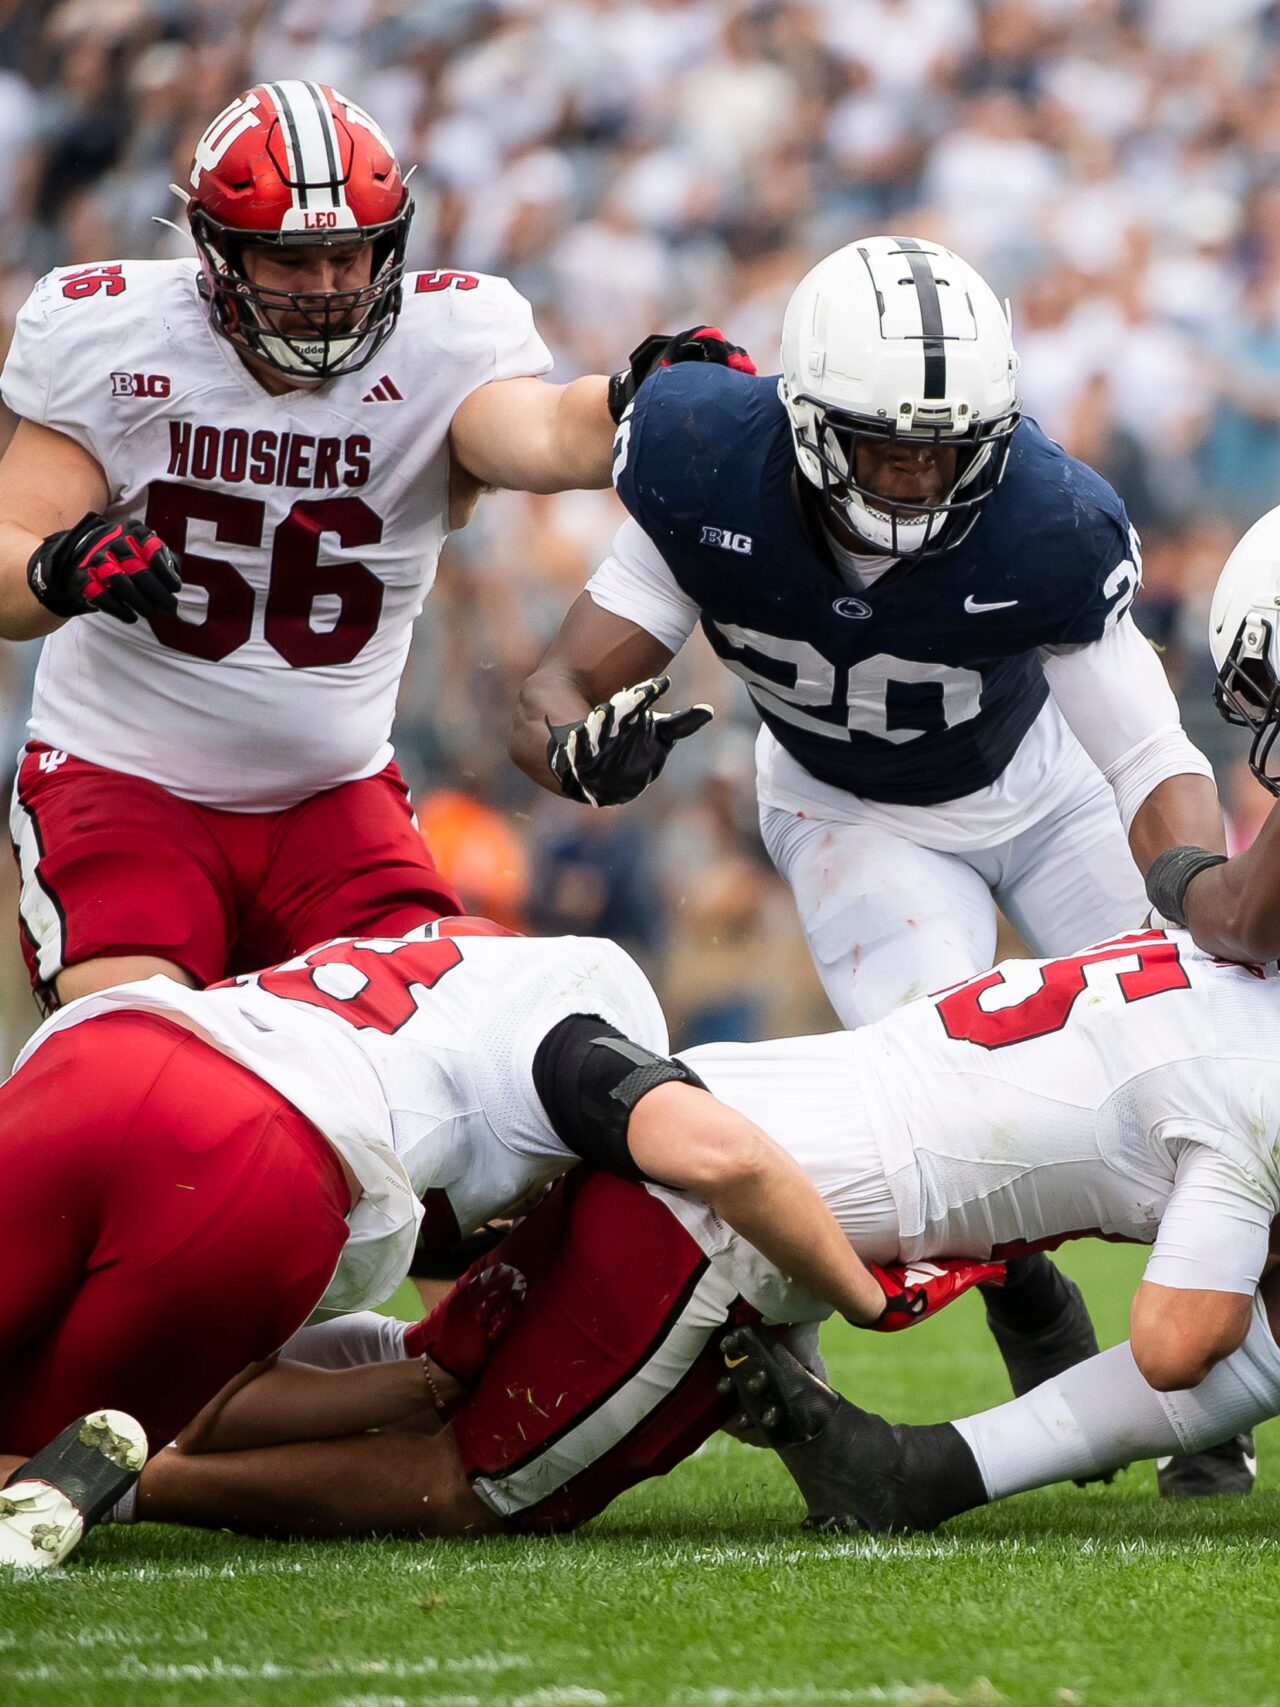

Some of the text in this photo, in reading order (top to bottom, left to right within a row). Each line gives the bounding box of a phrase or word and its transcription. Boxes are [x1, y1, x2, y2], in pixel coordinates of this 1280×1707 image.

[303, 211, 337, 229] LEO
[166, 420, 372, 490] HOOSIERS
[145, 479, 386, 669] 56
[712, 619, 984, 746] 20
